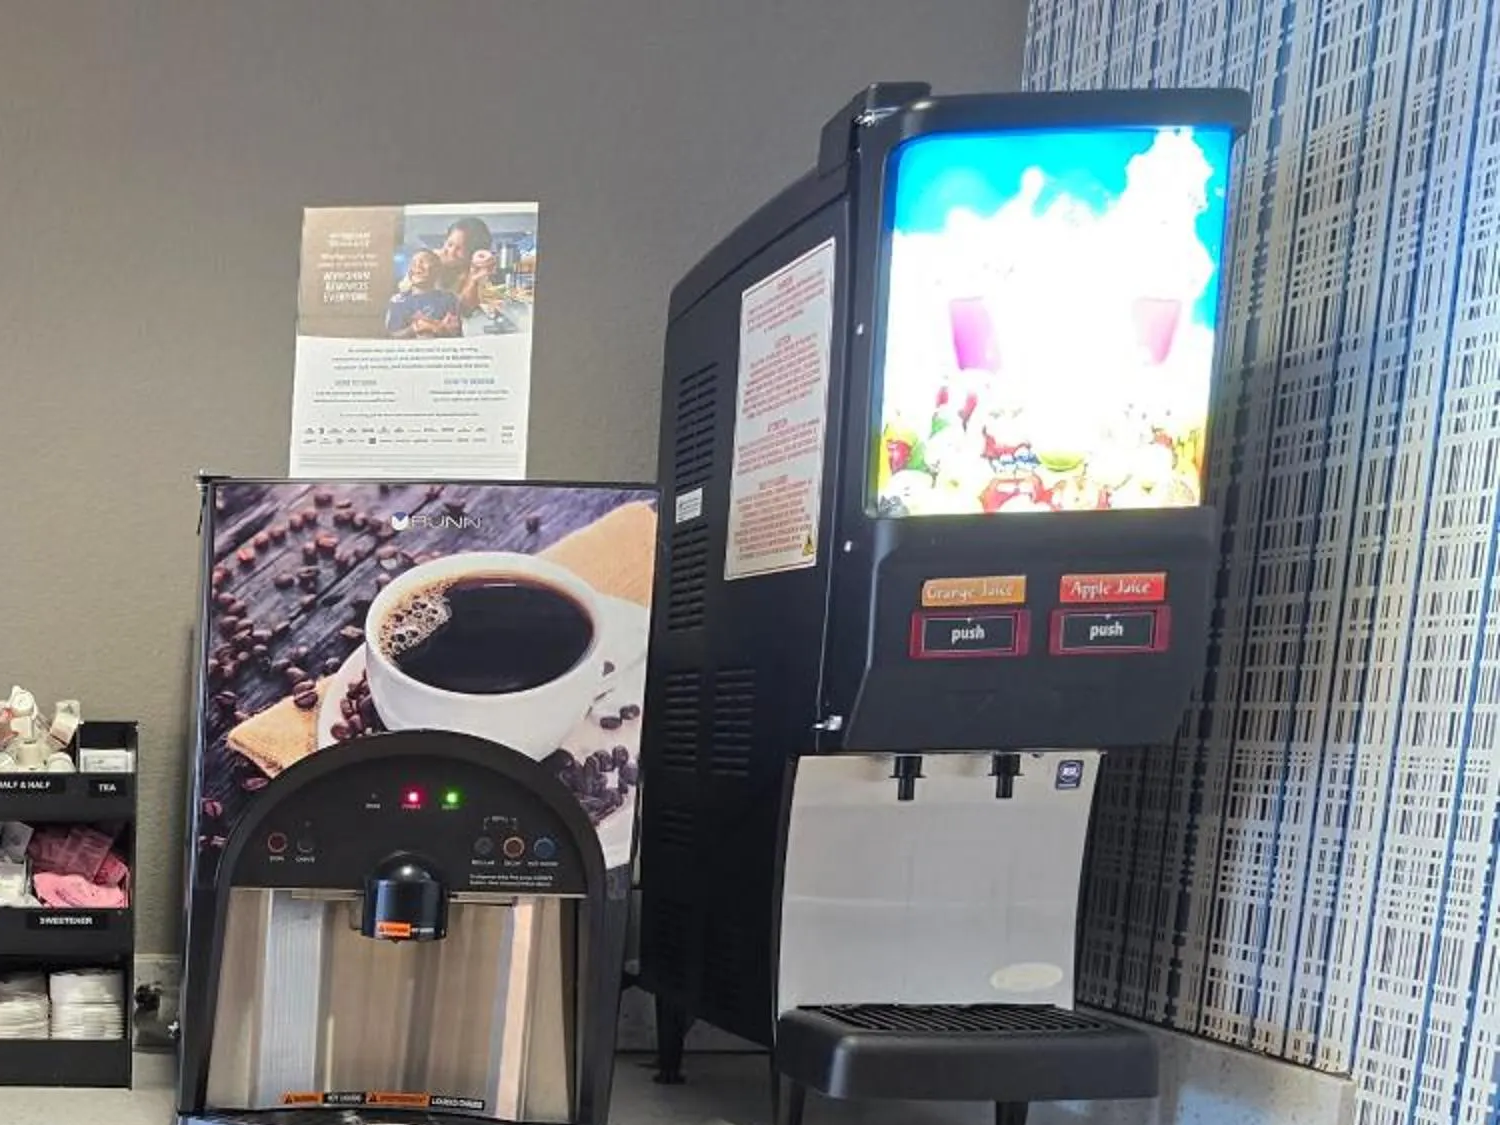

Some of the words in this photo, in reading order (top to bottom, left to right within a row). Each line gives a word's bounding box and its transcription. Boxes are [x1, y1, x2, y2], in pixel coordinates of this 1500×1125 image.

[411, 515, 481, 530] BUNN
[926, 584, 975, 601] Orange
[981, 581, 1013, 597] Juice
[1070, 581, 1109, 600] Apple
[1116, 580, 1151, 594] Juice
[951, 625, 986, 645] push
[1089, 622, 1124, 641] push
[20, 780, 27, 790] &
[27, 781, 51, 790] HALF
[99, 783, 117, 792] TEA
[39, 916, 93, 925] SWEETENER
